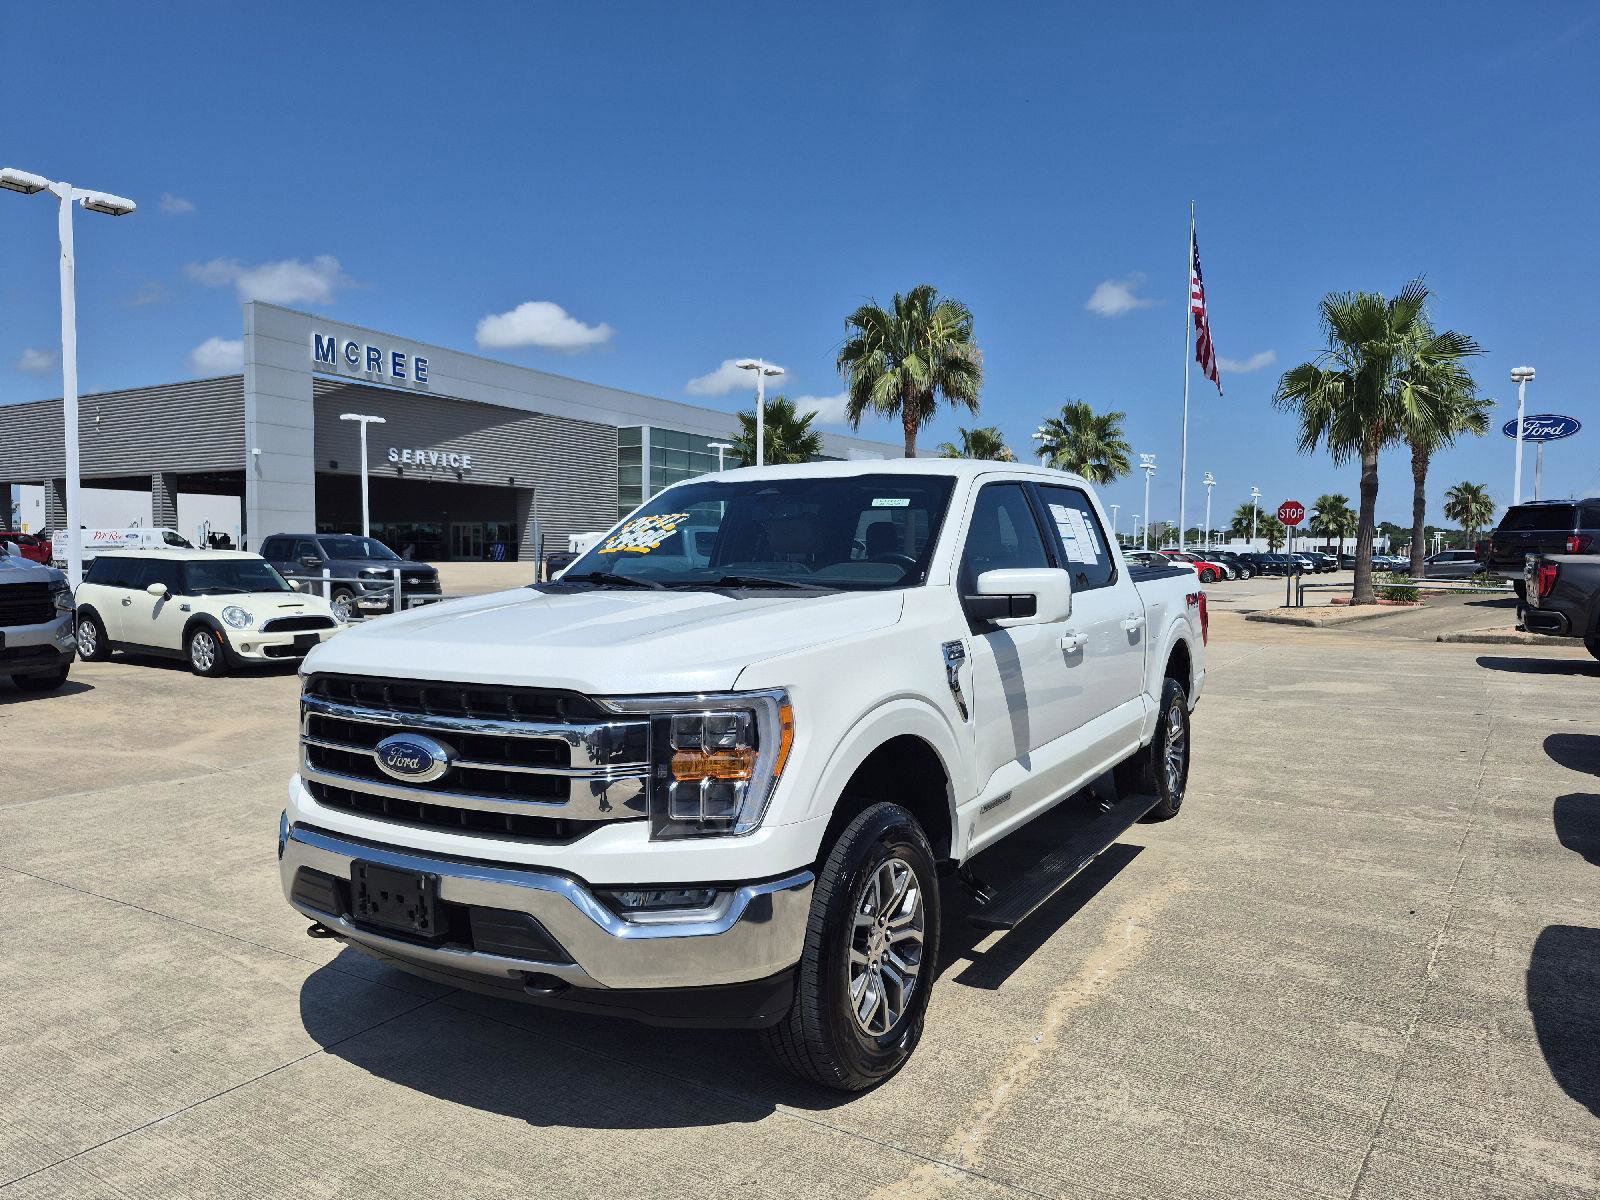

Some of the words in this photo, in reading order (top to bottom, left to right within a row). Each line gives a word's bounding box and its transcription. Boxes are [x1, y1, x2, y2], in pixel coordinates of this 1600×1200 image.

[1521, 419, 1566, 436] Ford
[388, 447, 472, 469] SERVICE
[1279, 508, 1304, 519] STOP
[387, 746, 421, 769] Ford
